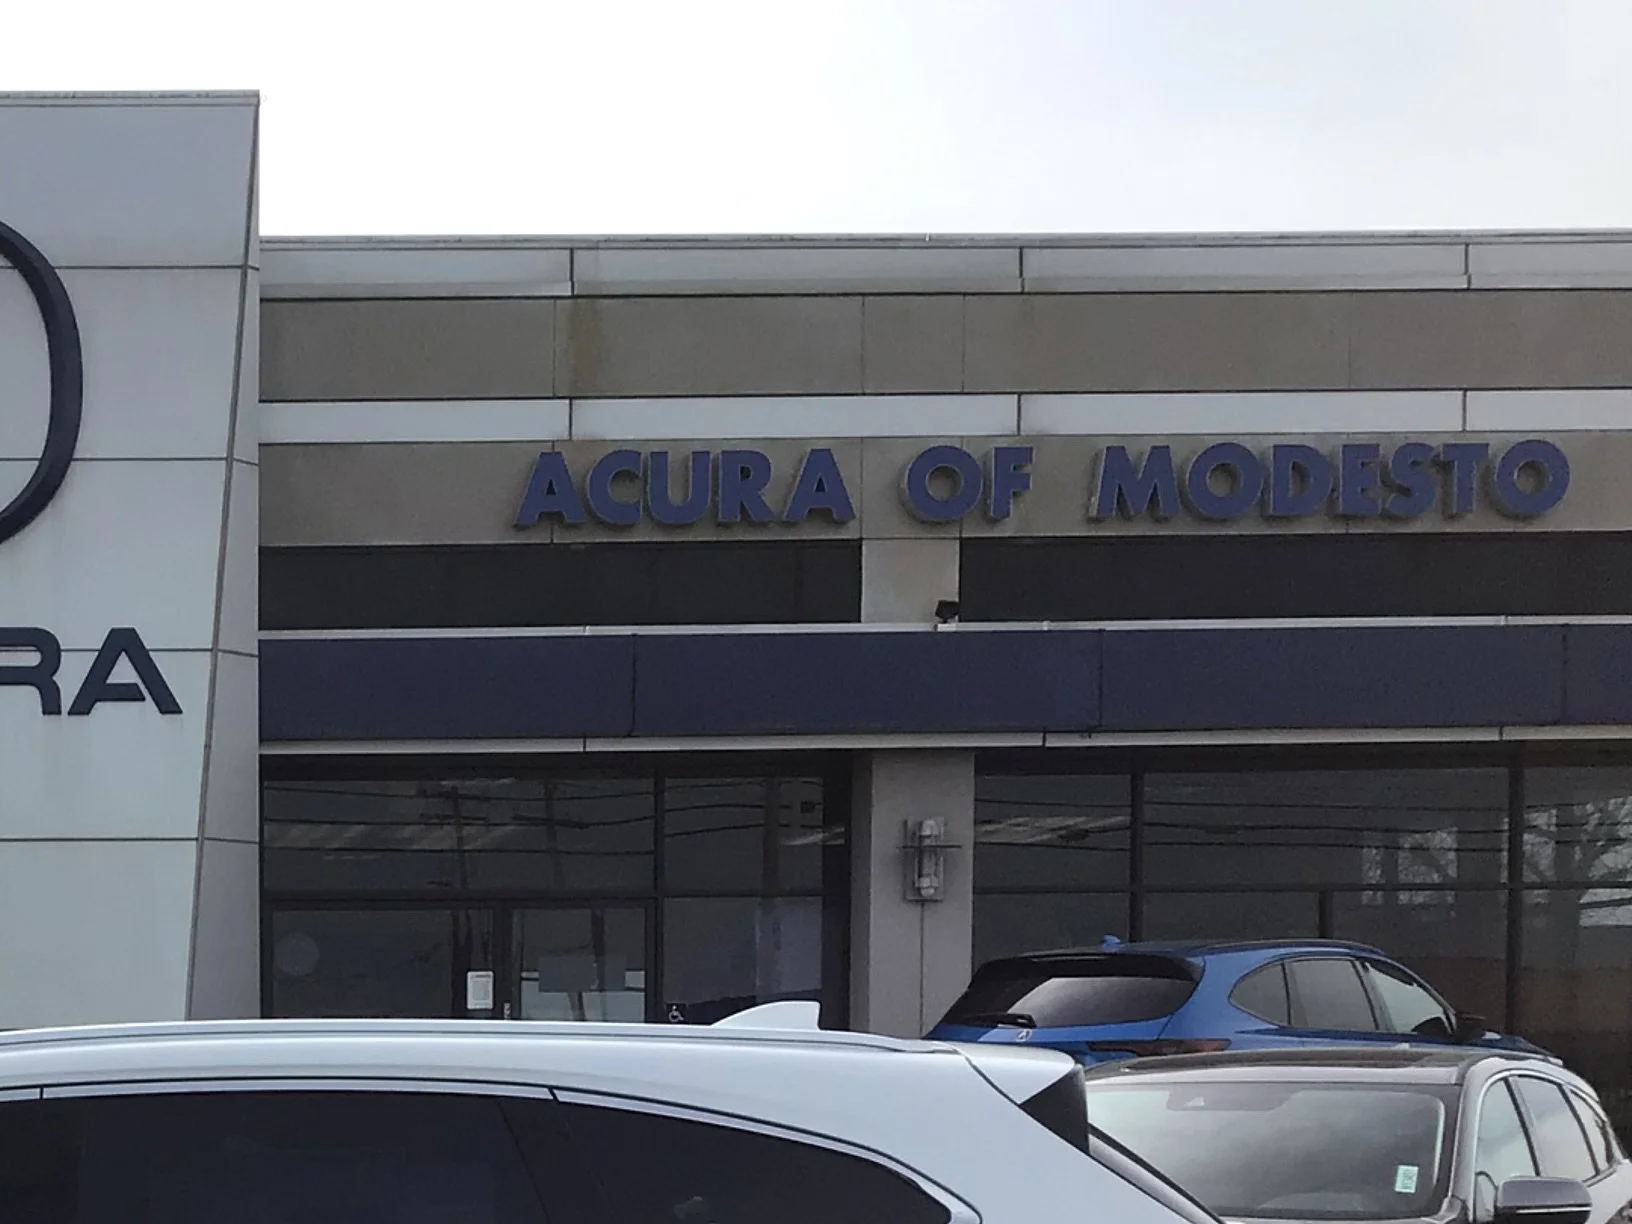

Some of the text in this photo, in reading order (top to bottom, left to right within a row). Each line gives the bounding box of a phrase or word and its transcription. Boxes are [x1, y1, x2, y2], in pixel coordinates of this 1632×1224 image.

[513, 438, 1571, 526] ACURA OF MODESTO
